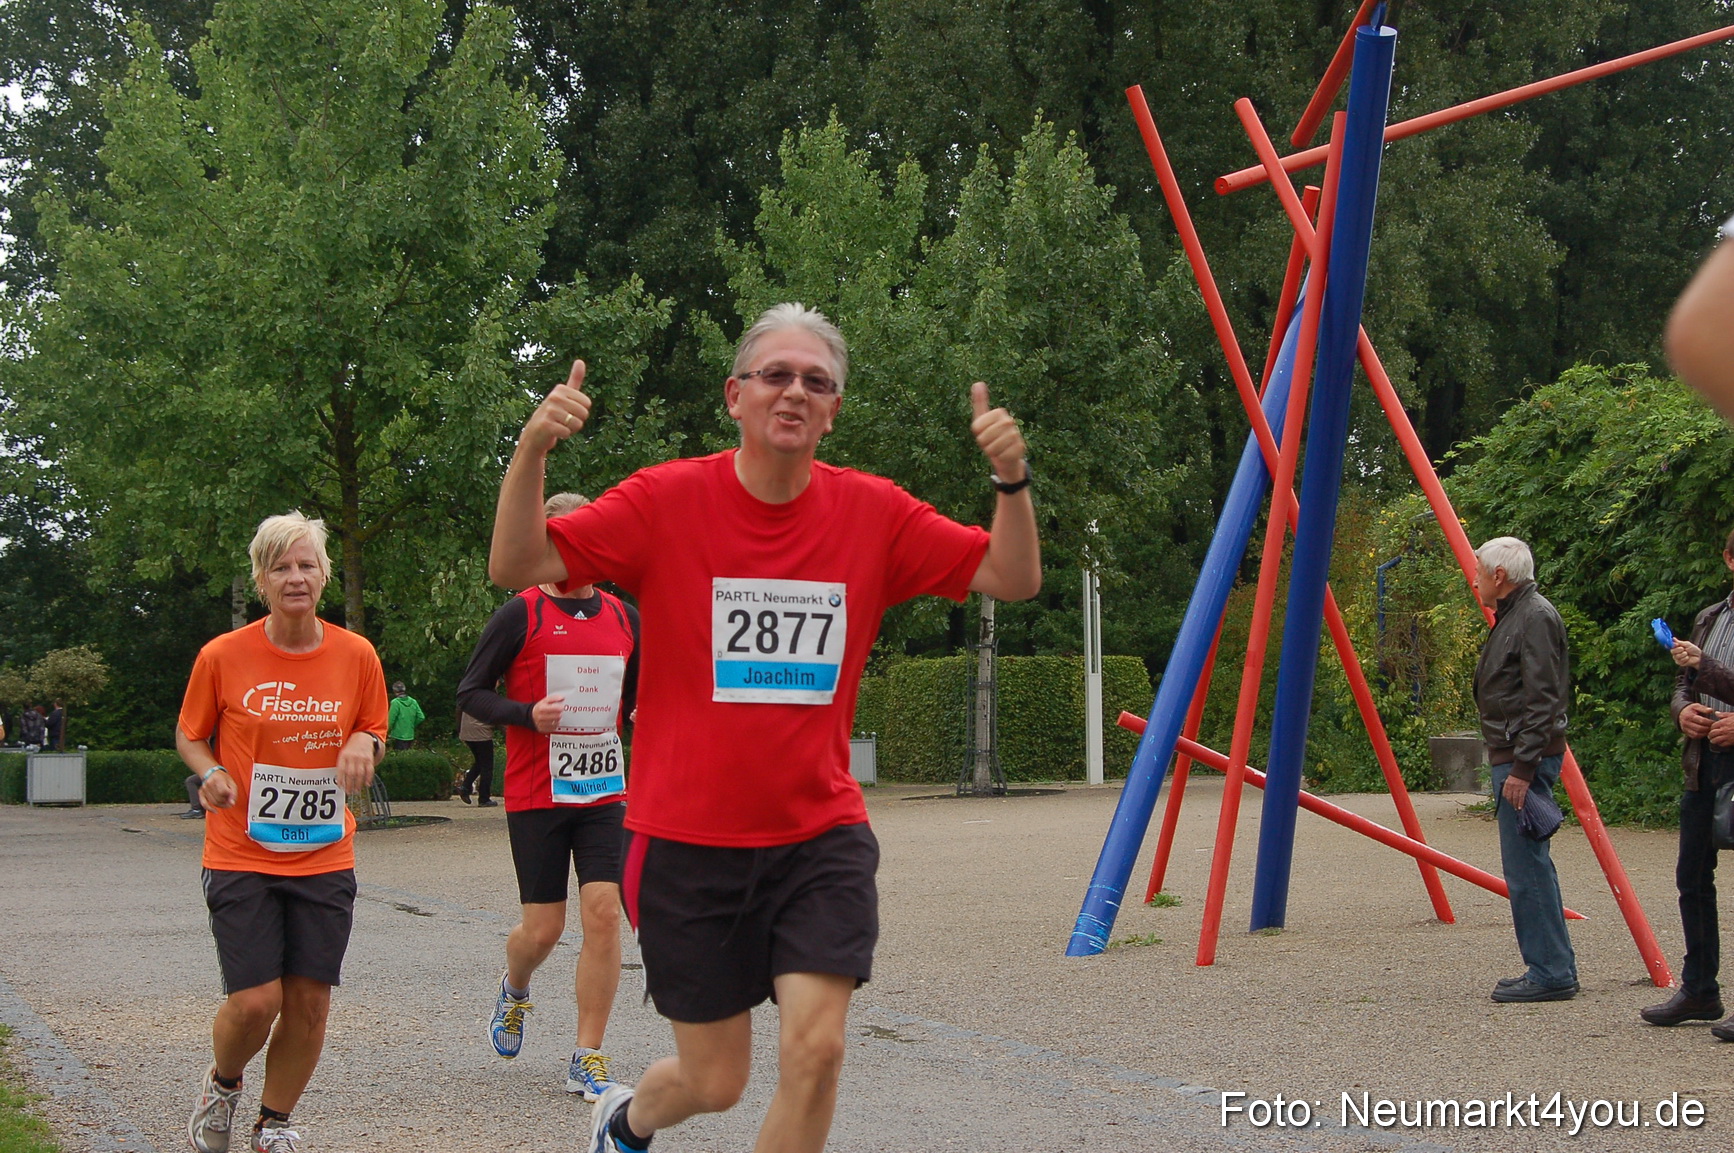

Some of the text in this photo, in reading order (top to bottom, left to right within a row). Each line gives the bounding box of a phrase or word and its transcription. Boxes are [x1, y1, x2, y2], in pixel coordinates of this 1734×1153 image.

[716, 591, 823, 605] PARTL Neumarkt
[727, 609, 833, 655] 2877
[577, 666, 599, 674] Dabei
[744, 667, 815, 685] Joachim
[261, 696, 341, 713] Fischer
[564, 704, 611, 713] Organspende
[270, 714, 337, 722] AUTOMOBILE
[301, 730, 318, 739] das
[552, 740, 611, 749] PARTL Neumarkt
[558, 748, 617, 777] 2486
[254, 773, 330, 785] PARTL Neumarkt
[571, 780, 607, 793] Wilfried
[258, 788, 336, 820] 2785
[282, 828, 309, 840] Gabi
